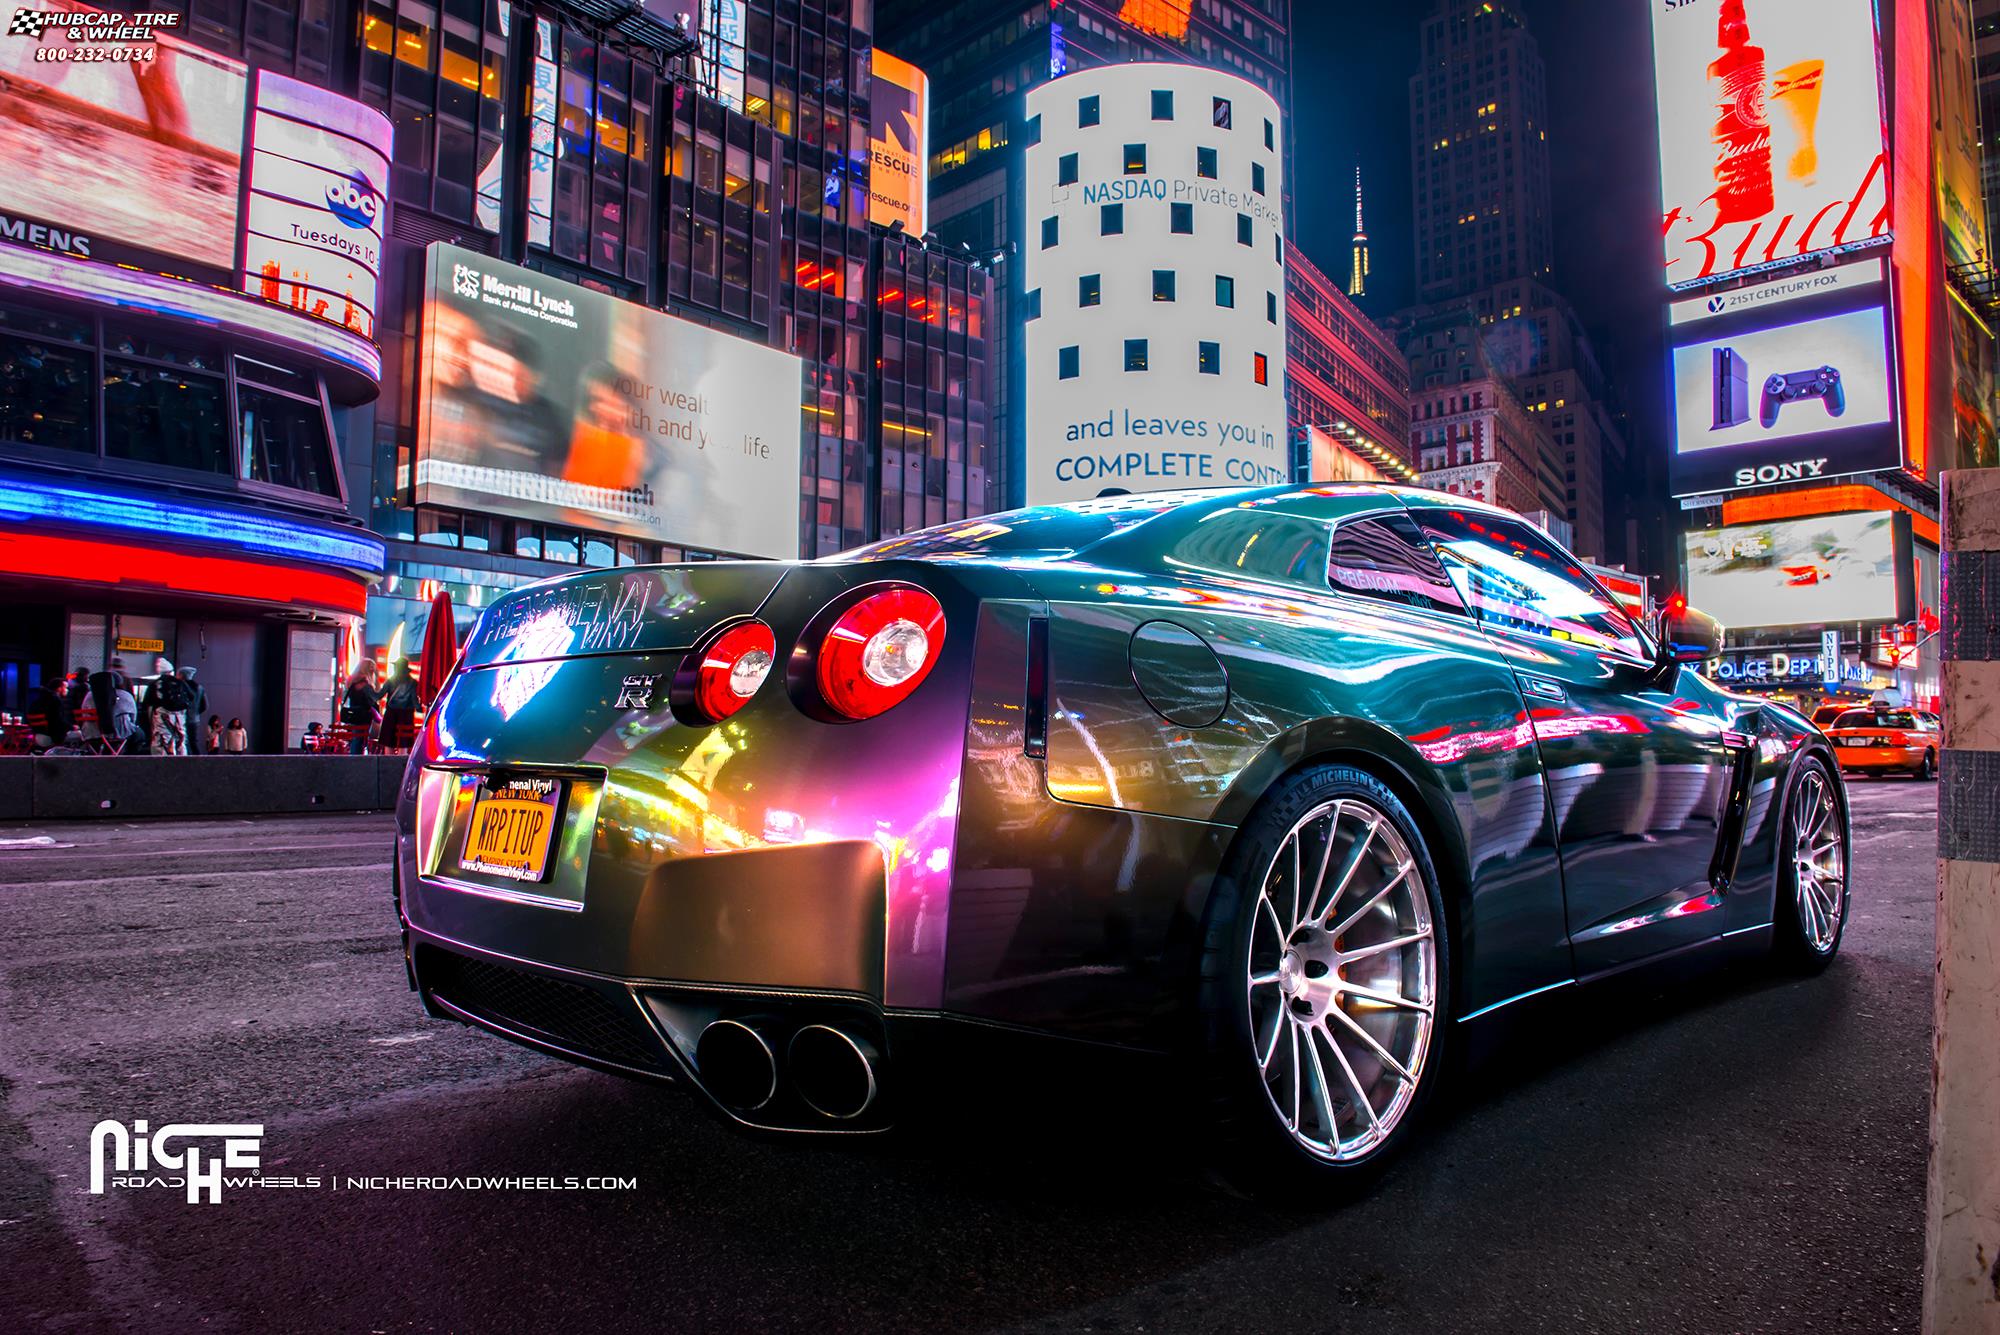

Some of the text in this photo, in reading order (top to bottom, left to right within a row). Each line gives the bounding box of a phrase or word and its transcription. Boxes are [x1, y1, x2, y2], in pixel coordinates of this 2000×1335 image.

[326, 179, 376, 218] abc
[1084, 178, 1167, 205] NASDAQ
[1174, 180, 1238, 209] Private
[0, 215, 90, 256] MENS
[291, 223, 375, 264] Tuesdays 10
[482, 274, 574, 317] Merrill Lynch
[1730, 274, 1839, 306] 21ST CENTURY FOX
[482, 293, 578, 329] Bank of America Corporation
[611, 376, 653, 401] your
[658, 417, 693, 441] and
[1066, 408, 1275, 450] and leaves you in
[1055, 452, 1213, 482] COMPLETE
[1735, 458, 1828, 487] SONY
[1706, 657, 1767, 679] POLICE
[1825, 632, 1836, 681] NYPD
[532, 779, 553, 794] Vinyl
[1311, 769, 1369, 790] MICHELIN
[477, 807, 544, 857] WRPITUP
[461, 861, 538, 881] www.PhenomenalVinyl.com
